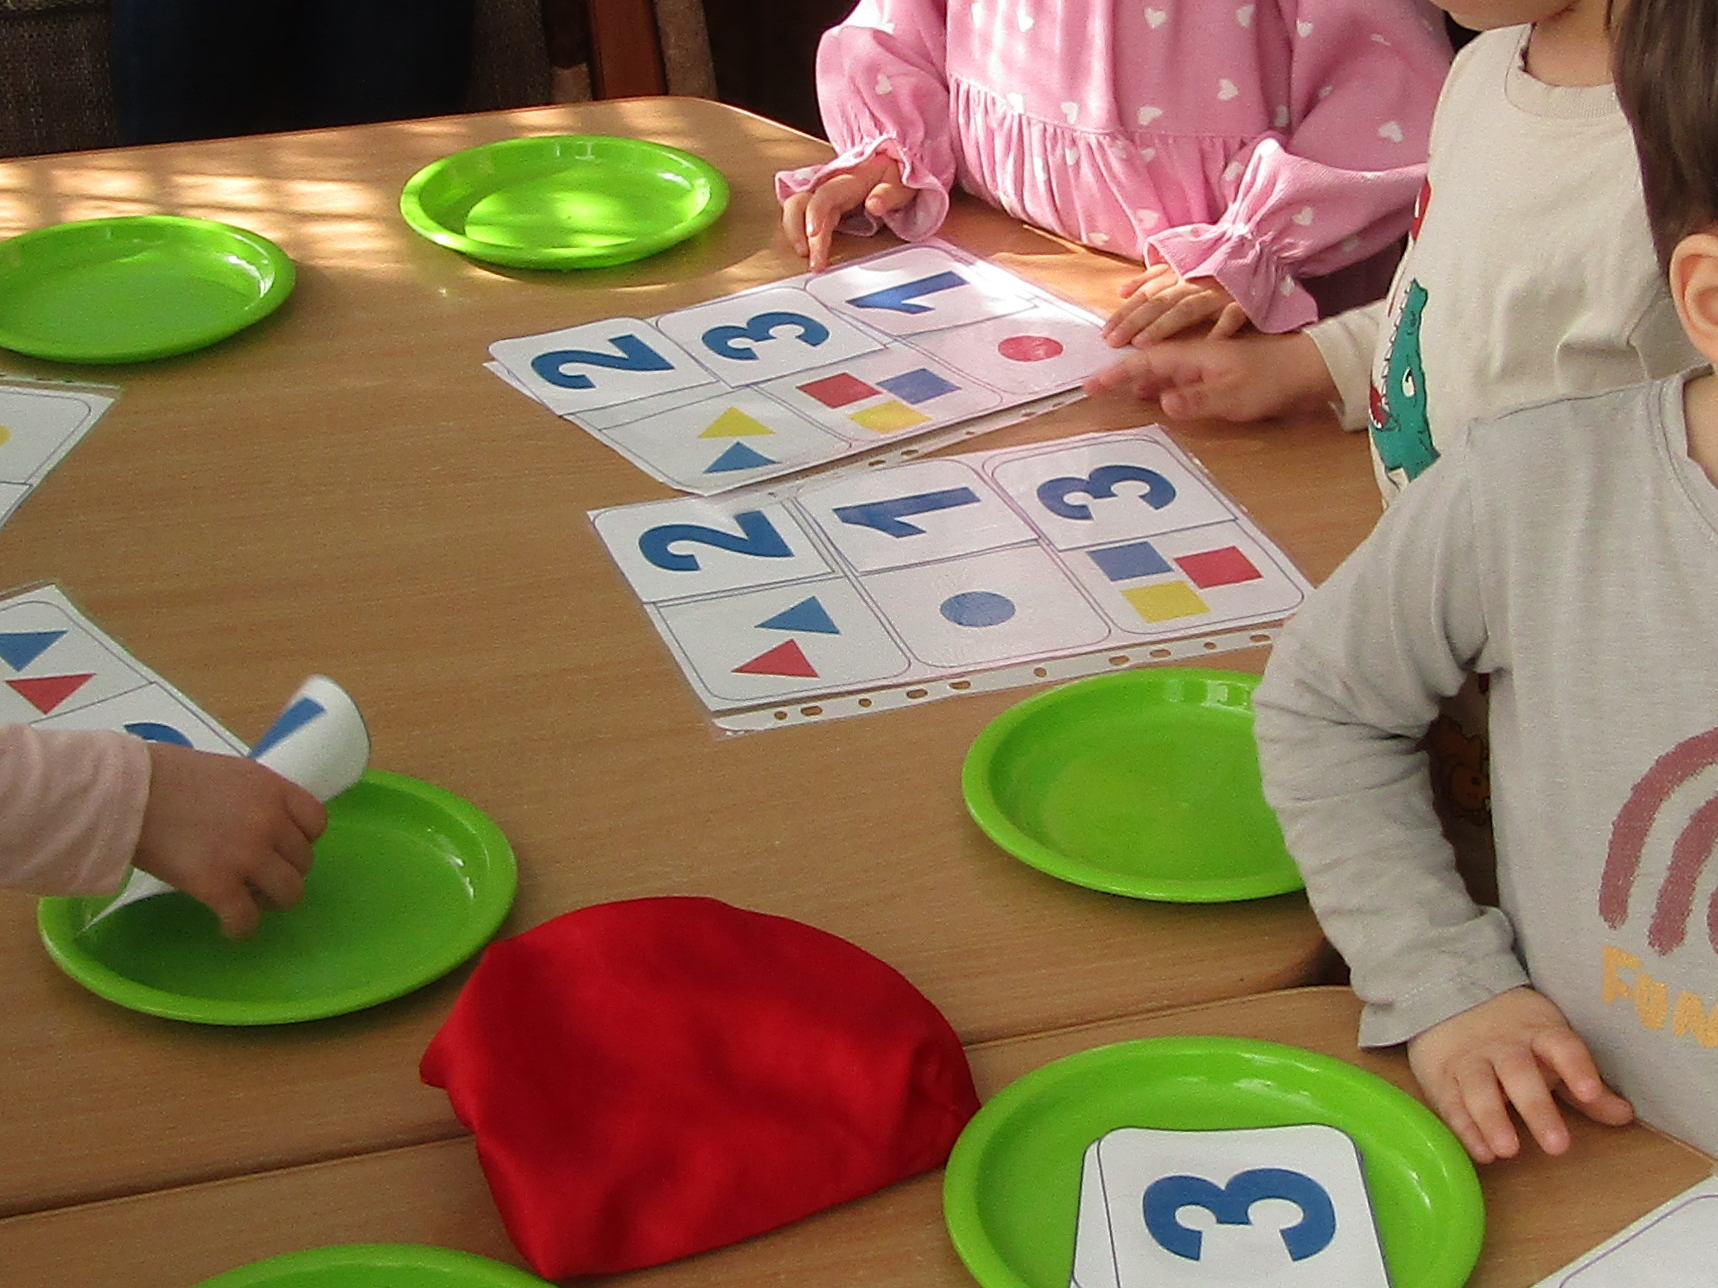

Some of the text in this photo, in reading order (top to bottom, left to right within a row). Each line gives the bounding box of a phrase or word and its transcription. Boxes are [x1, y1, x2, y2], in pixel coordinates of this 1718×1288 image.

[845, 270, 969, 315] 1
[530, 334, 676, 391] 2
[701, 310, 831, 361] 3
[831, 486, 982, 540] 1
[1036, 463, 1177, 522] 3
[637, 510, 794, 573] 2
[1140, 1166, 1338, 1263] 3
